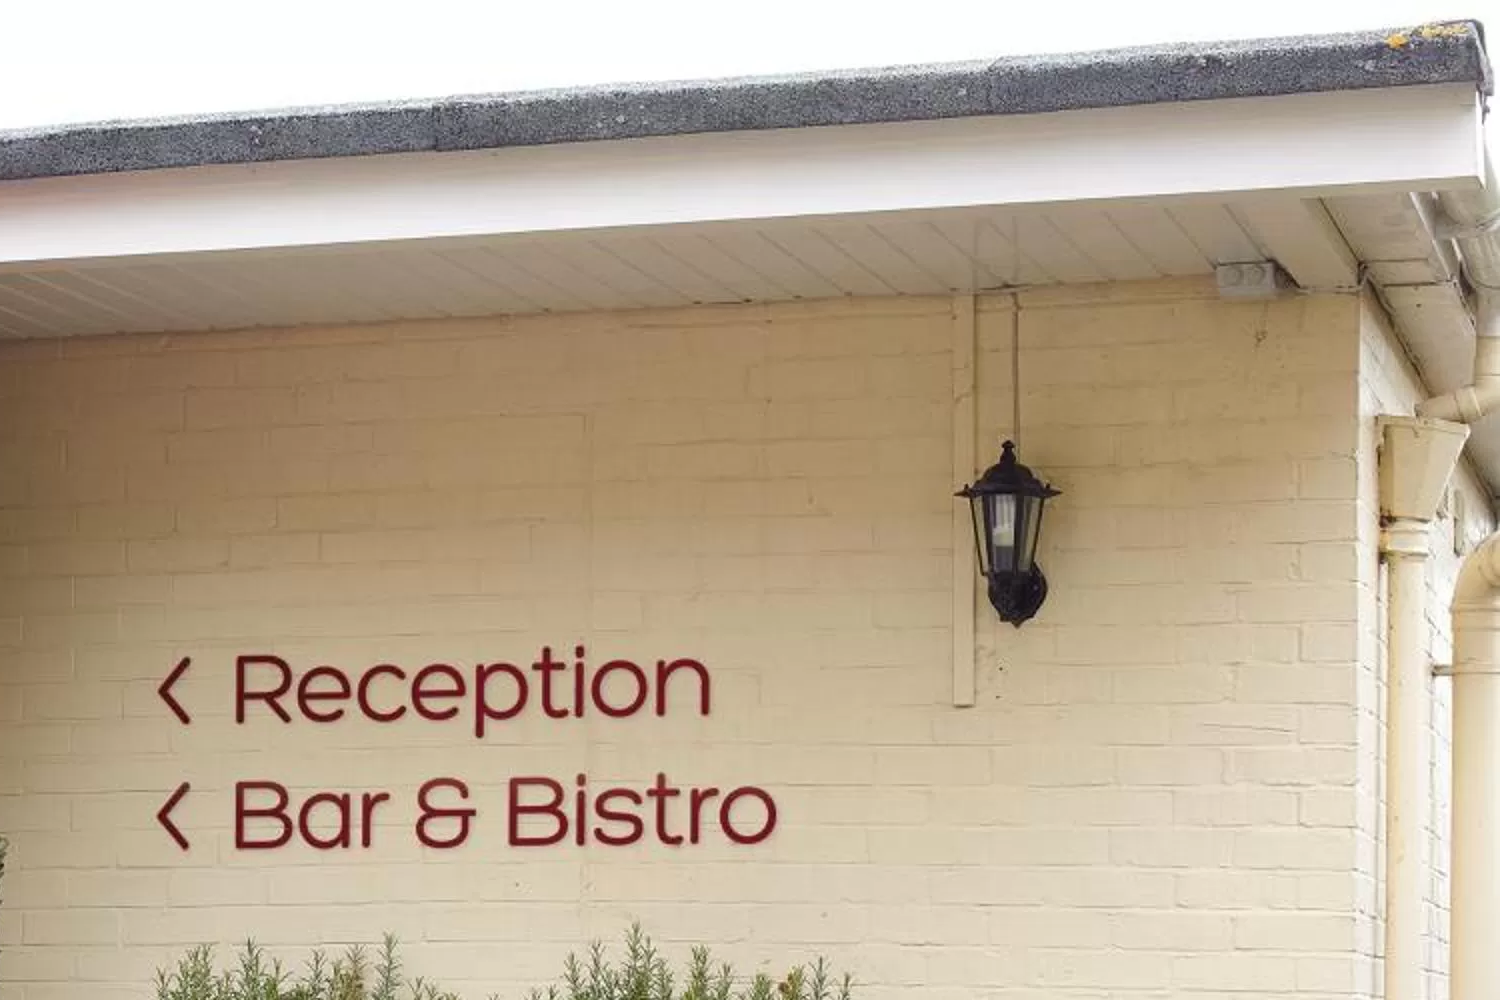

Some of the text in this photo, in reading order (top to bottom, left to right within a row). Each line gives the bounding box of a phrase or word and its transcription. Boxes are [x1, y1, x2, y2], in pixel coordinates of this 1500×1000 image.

[235, 645, 711, 739] Reception
[235, 772, 777, 850] Bar & Bistro
